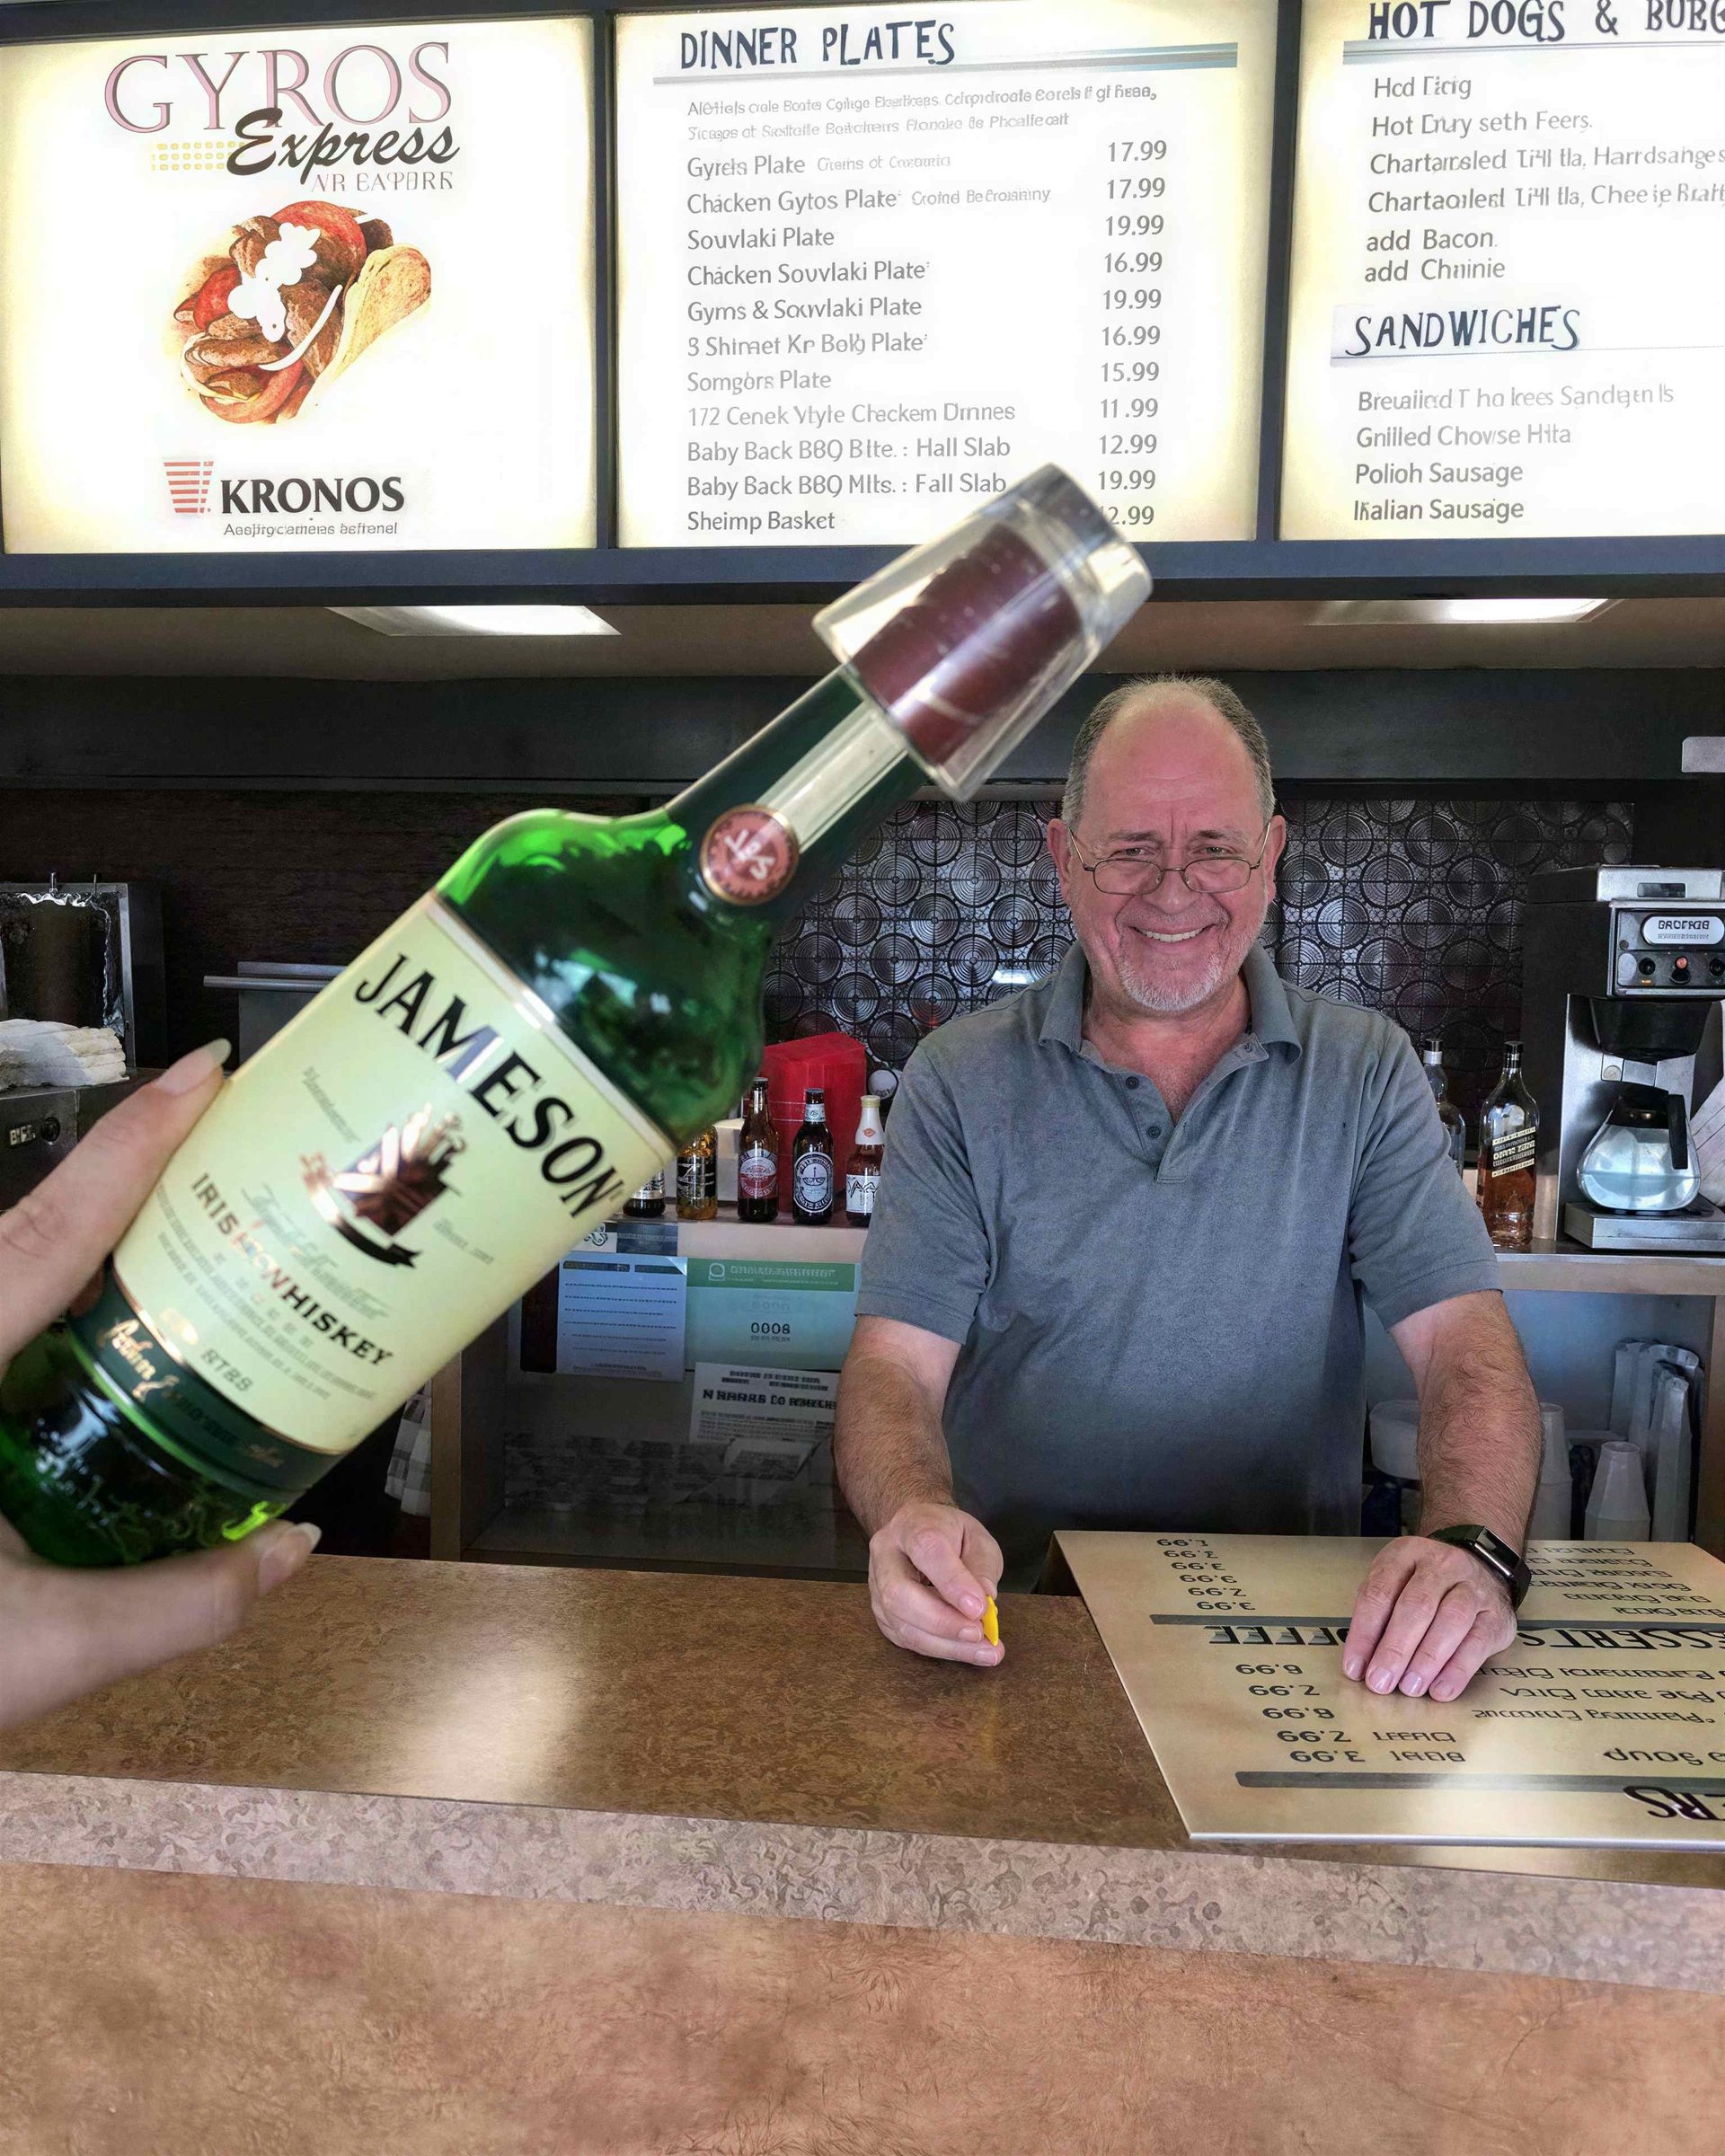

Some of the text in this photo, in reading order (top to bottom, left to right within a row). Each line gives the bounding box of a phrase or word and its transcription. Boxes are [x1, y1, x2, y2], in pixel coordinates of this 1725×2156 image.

[1367, 0, 1450, 40] HOT
[1466, 0, 1566, 41] DOGS
[1594, 0, 1619, 36] &
[680, 19, 955, 70] DINNER PLATES
[103, 41, 452, 134] GYROS
[1372, 115, 1414, 137] Hot
[226, 107, 462, 185] Express
[754, 154, 806, 175] Plate
[1108, 139, 1167, 163] 17.99
[1107, 176, 1166, 199] 17.99
[687, 214, 1164, 251] Souvlaki Plate 19.99
[1366, 228, 1411, 252] add
[777, 261, 868, 284] Souvlaki
[1104, 252, 1163, 274] 16.99
[1364, 259, 1409, 283] add
[752, 299, 769, 320] &
[870, 296, 923, 317] Plate
[1102, 288, 1163, 310] 19.99
[1101, 324, 1161, 347] 16.99
[1345, 305, 1580, 357] SANDWICHES
[779, 368, 832, 390] Plate
[1101, 361, 1160, 383] 15.99
[1100, 397, 1159, 419] 11.99
[687, 440, 739, 466] Baby
[744, 439, 793, 461] Back
[799, 438, 844, 463] BBQ
[916, 437, 958, 457] Hall
[963, 435, 1011, 457] Slab
[1099, 433, 1158, 455] 12.99
[687, 475, 739, 501] Baby
[744, 474, 793, 496] Back
[799, 474, 843, 499] BBQ
[916, 473, 953, 493] Fall
[958, 469, 1008, 497] Slab
[1098, 469, 1156, 490] 19.99
[1429, 462, 1524, 489] Sausage
[220, 475, 405, 515] KRONOS
[687, 510, 763, 535] Sheimp
[767, 509, 836, 530] Basket
[1429, 498, 1525, 525] Sausage
[356, 953, 627, 1222] JAMESON
[1196, 1602, 1255, 1610] 3.99
[1203, 1626, 1350, 1646] FFEE
